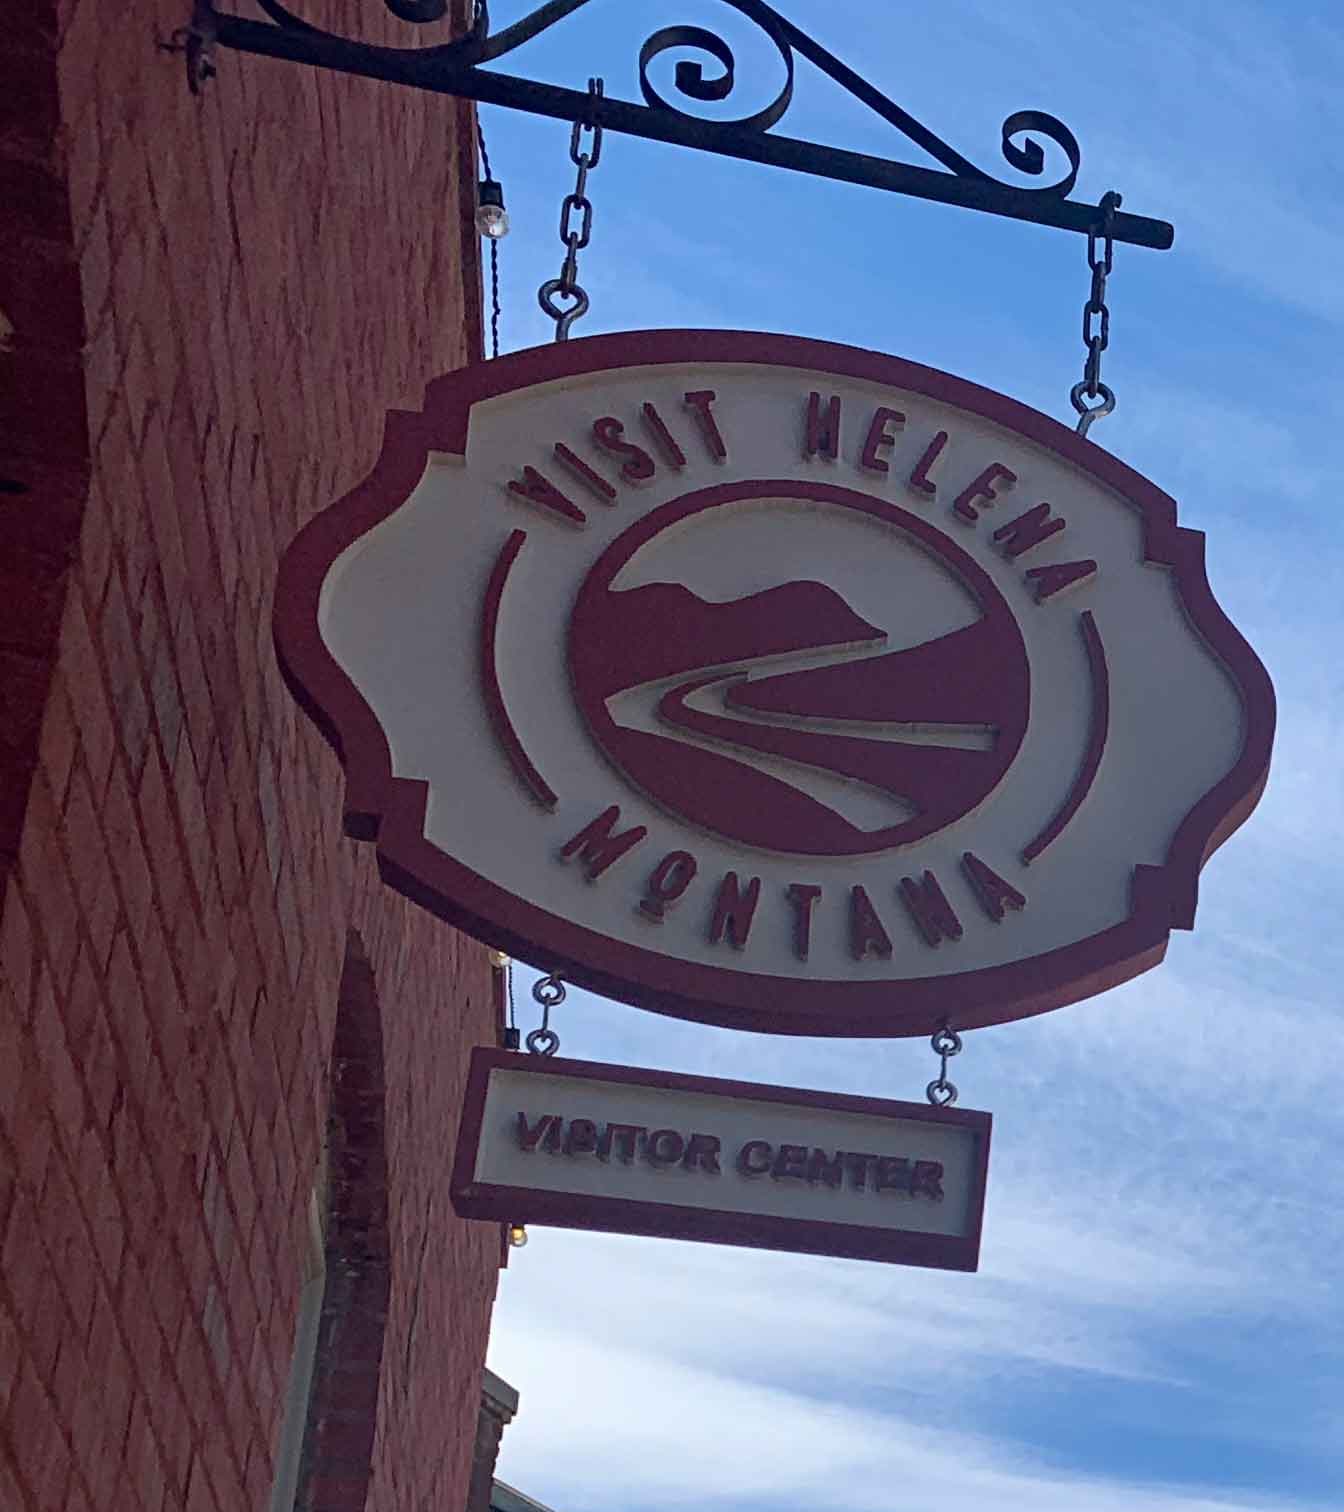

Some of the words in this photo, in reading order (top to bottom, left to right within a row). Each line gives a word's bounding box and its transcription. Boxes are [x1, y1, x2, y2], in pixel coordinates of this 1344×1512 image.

[507, 390, 728, 524] VISIT
[806, 390, 1098, 603] HELENA
[560, 804, 1027, 961] MONTANA
[515, 1110, 722, 1176] VISITOR
[737, 1139, 946, 1200] CENTER
